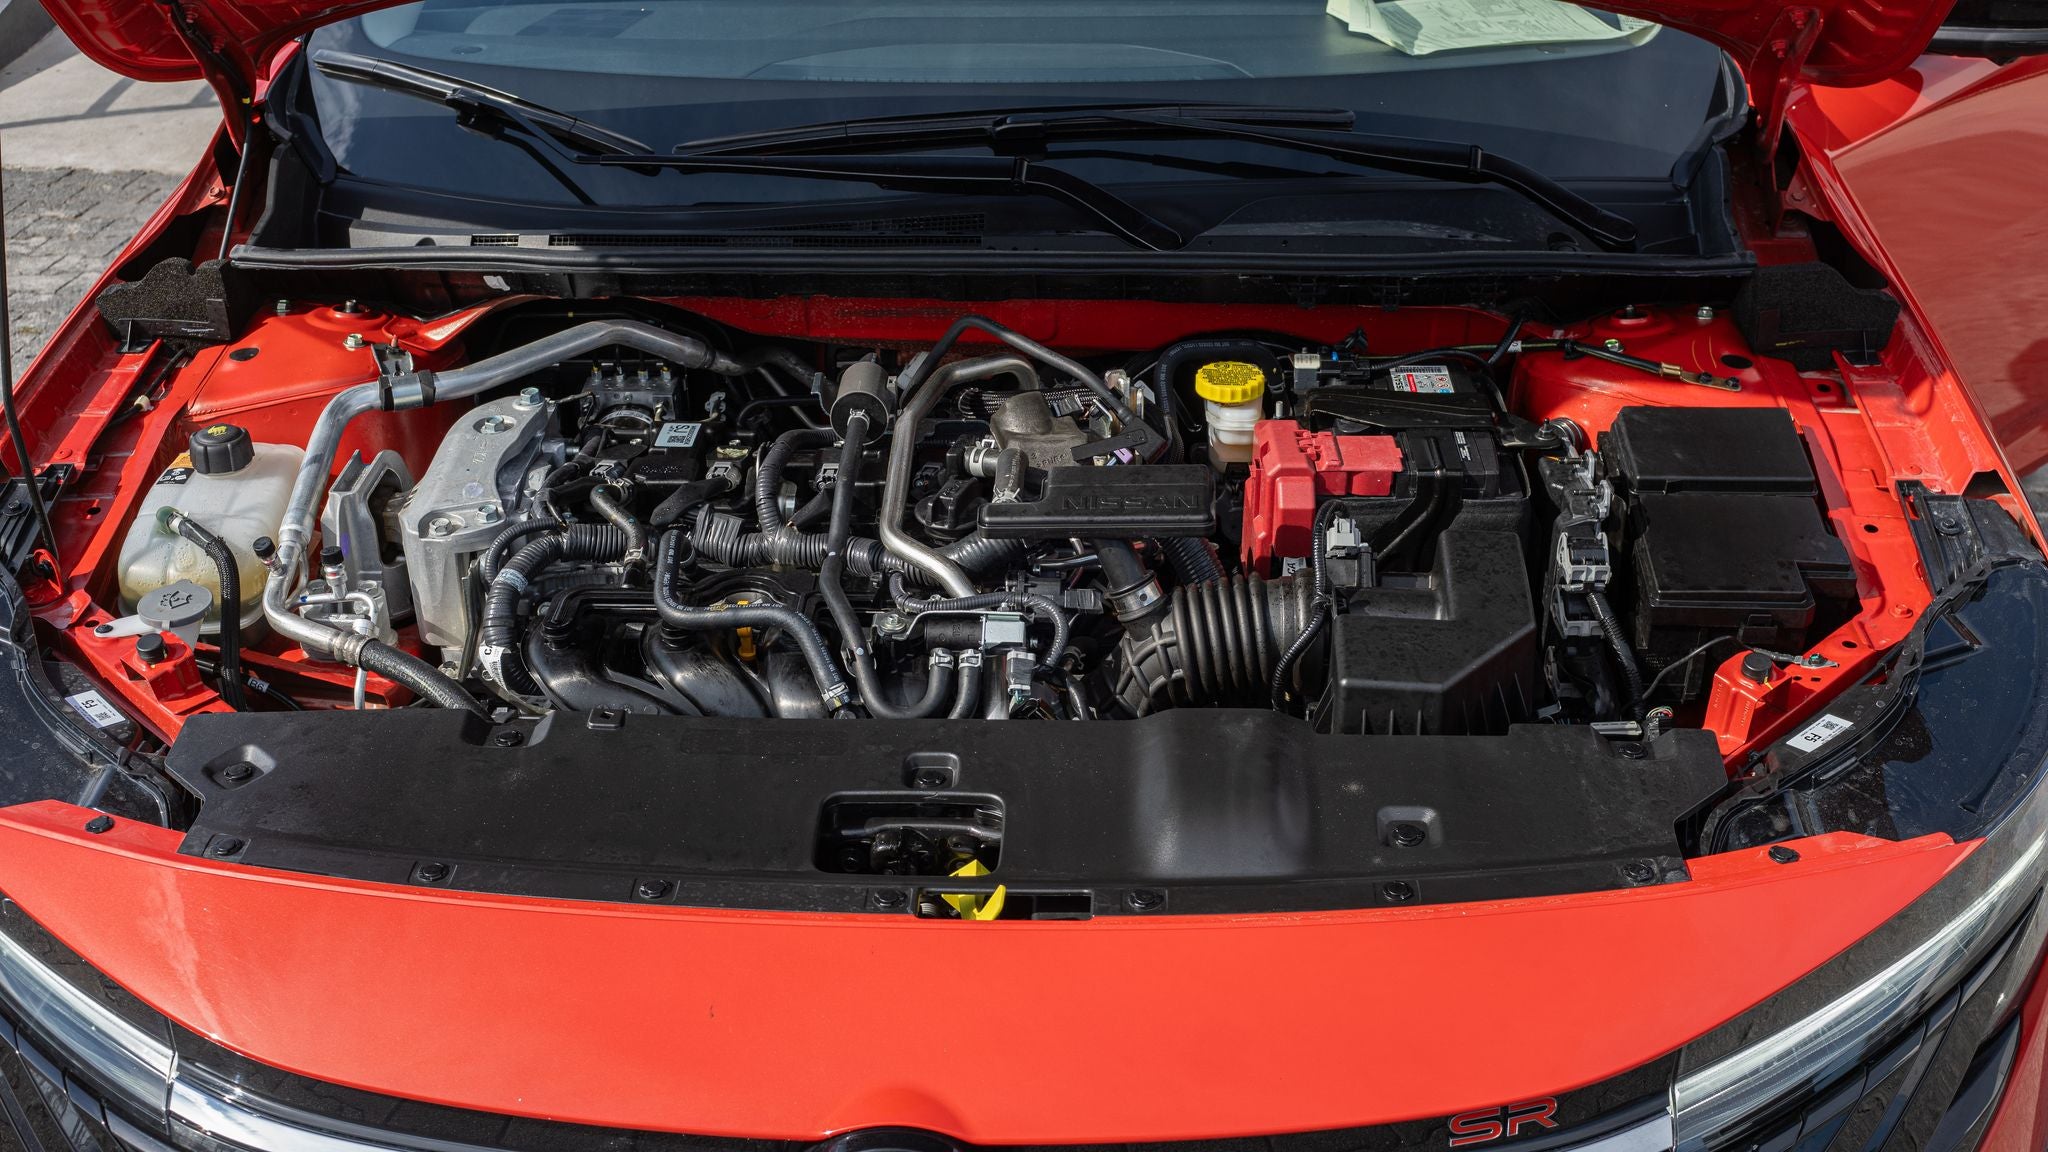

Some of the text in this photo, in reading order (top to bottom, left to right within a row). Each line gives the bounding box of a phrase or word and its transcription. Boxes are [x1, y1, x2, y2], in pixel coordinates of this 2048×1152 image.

[1062, 495, 1200, 510] NISSAN
[81, 699, 98, 709] F5
[1804, 732, 1822, 743] F5
[1449, 1096, 1560, 1148] SR
